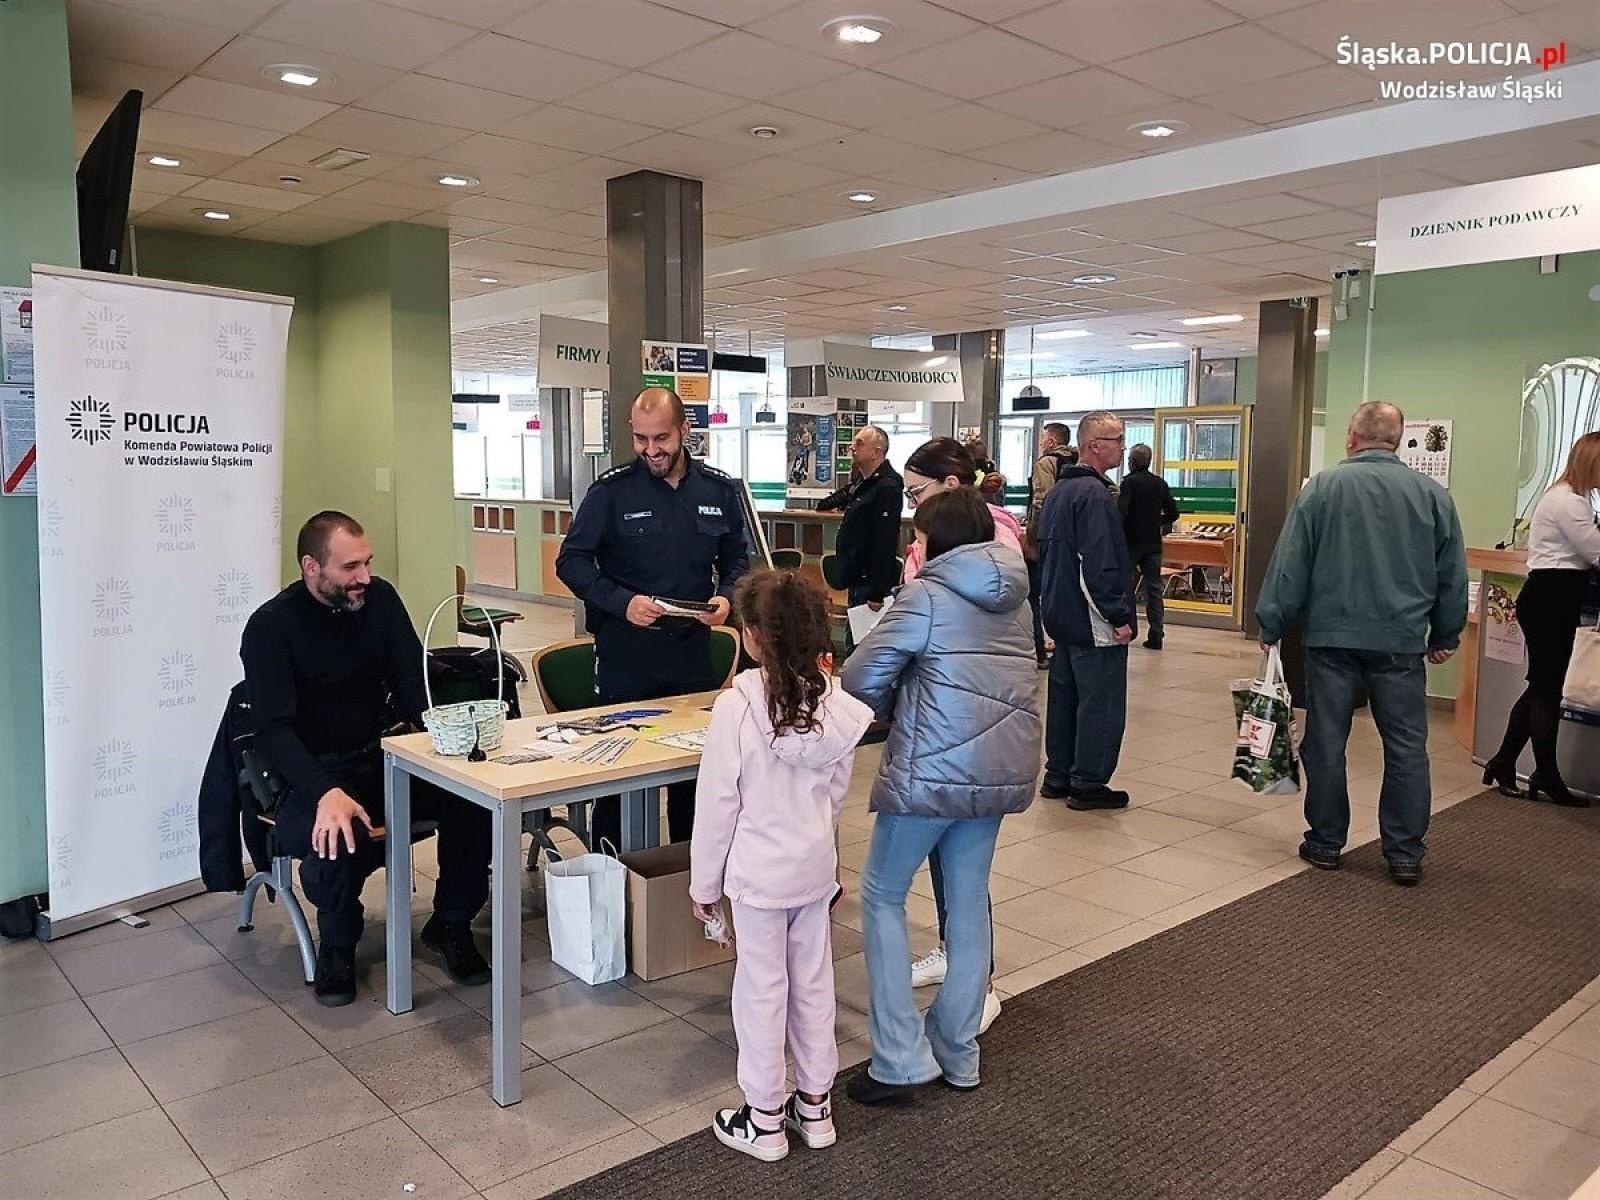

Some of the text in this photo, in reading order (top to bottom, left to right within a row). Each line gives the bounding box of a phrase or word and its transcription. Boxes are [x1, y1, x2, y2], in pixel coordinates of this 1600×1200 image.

[1410, 204, 1582, 238] DZIENNIK PODAWCZY
[556, 344, 601, 363] FIRMY
[86, 358, 131, 370] POLICJA
[216, 367, 255, 379] POLICJA
[827, 361, 959, 383] ŚWIADCZENIOBIORCY
[124, 412, 210, 434] POLICJA
[124, 440, 273, 455] Komenda Powiatowa Policji
[124, 457, 134, 465] w
[211, 455, 253, 468] Śląskim
[156, 541, 196, 552] POLICJA
[93, 624, 134, 638] POLICJA
[159, 695, 197, 709] POLICJA
[94, 783, 137, 799] POLICJA
